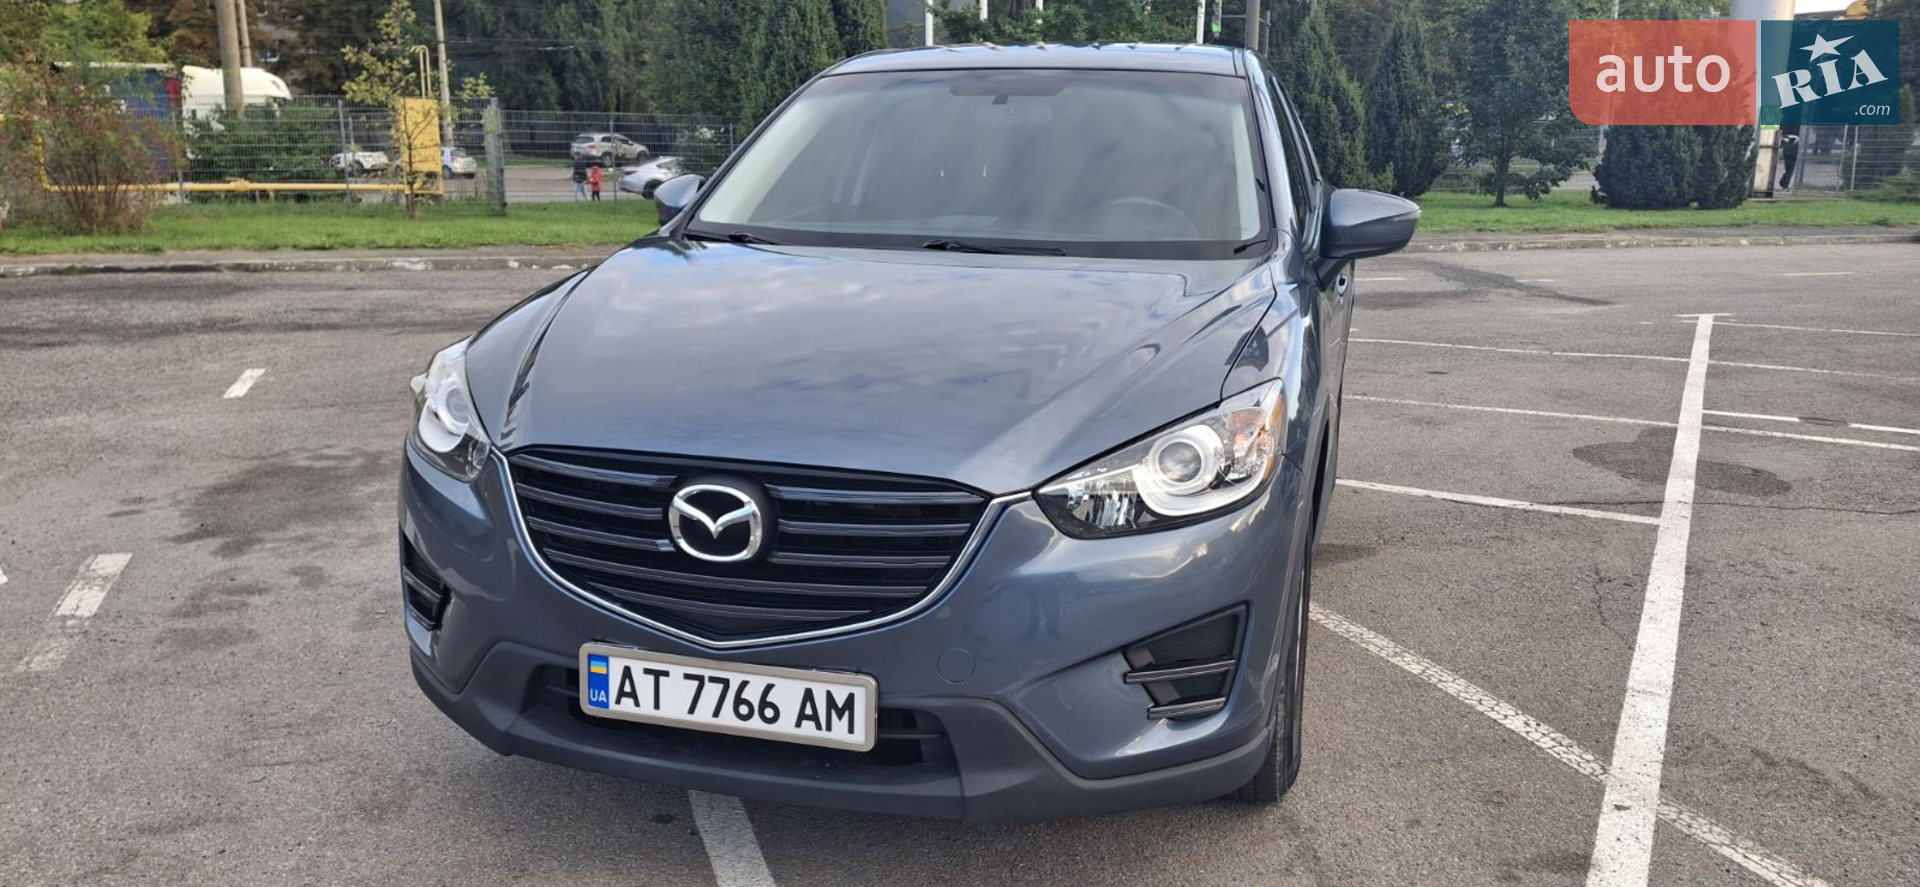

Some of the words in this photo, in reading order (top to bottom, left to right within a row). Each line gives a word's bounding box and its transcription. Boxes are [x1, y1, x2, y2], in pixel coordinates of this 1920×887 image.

[589, 688, 607, 703] UA
[614, 665, 670, 711] AT
[683, 673, 781, 725] 7766
[794, 687, 855, 735] AM
